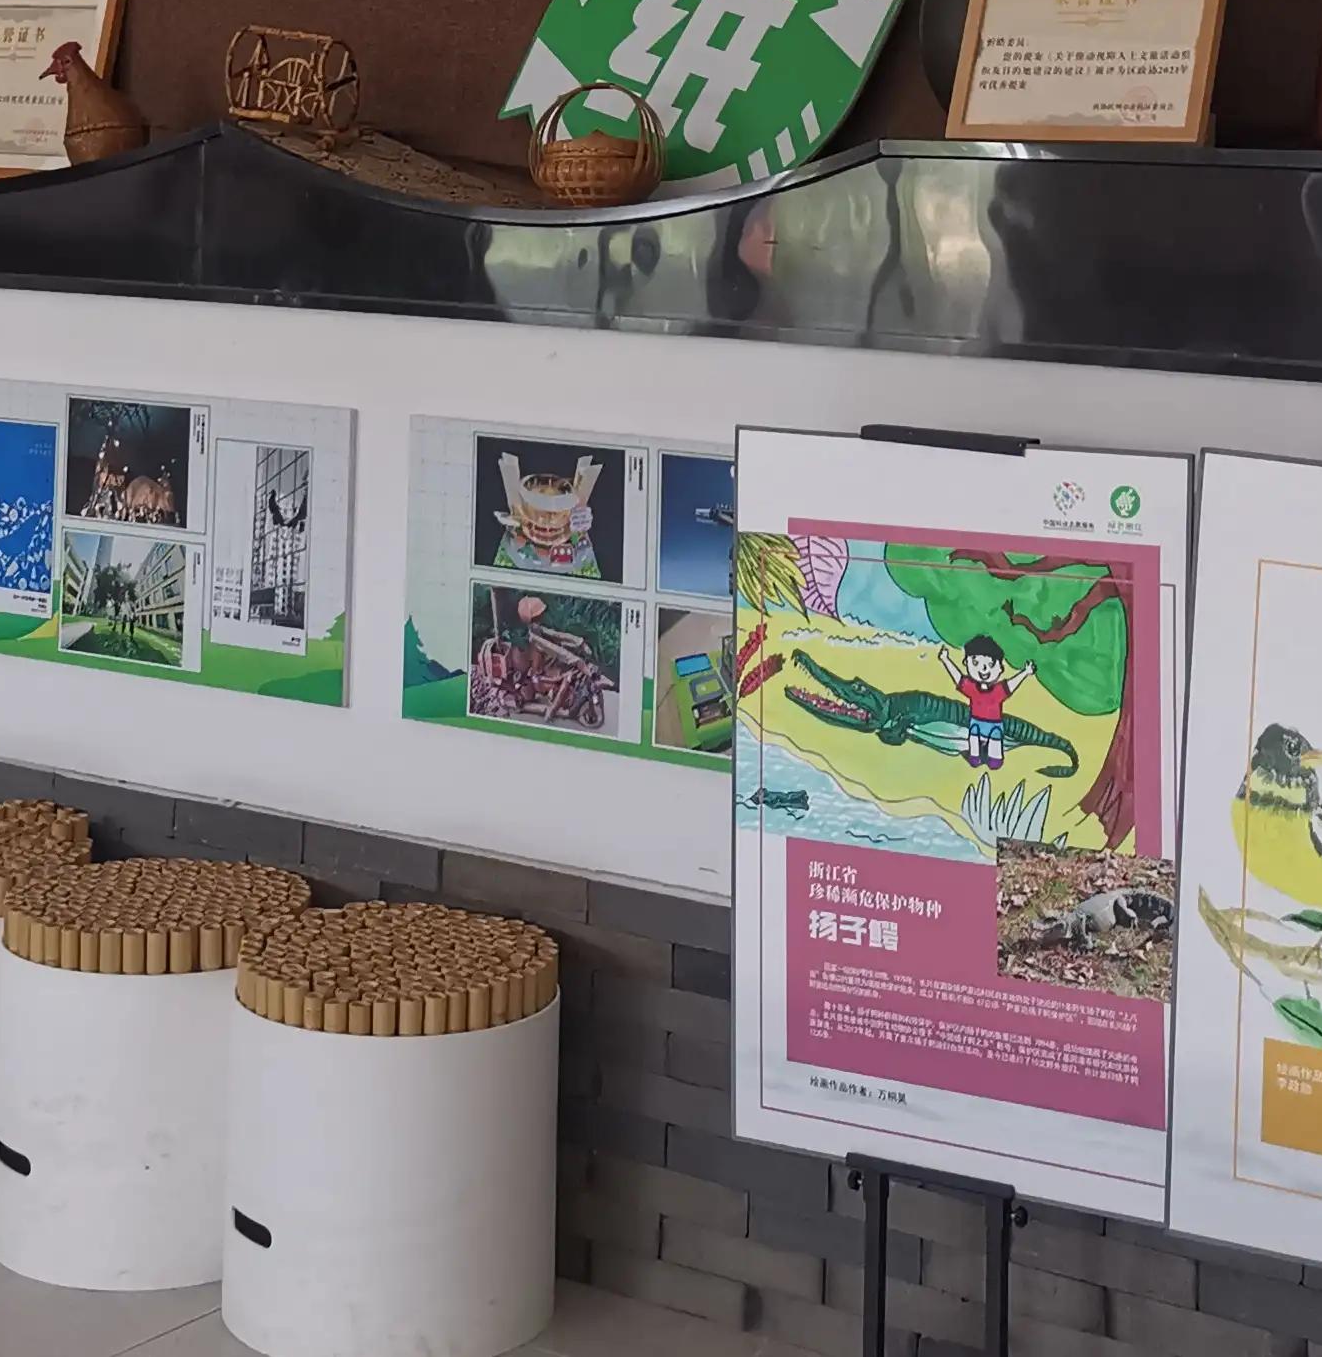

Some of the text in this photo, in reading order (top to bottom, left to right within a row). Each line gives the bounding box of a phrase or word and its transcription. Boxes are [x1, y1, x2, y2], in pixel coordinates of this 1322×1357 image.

[809, 860, 857, 885] 浙江省
[809, 883, 942, 919] 珍稀濒危保护物种
[809, 909, 899, 952] 扬子鳄
